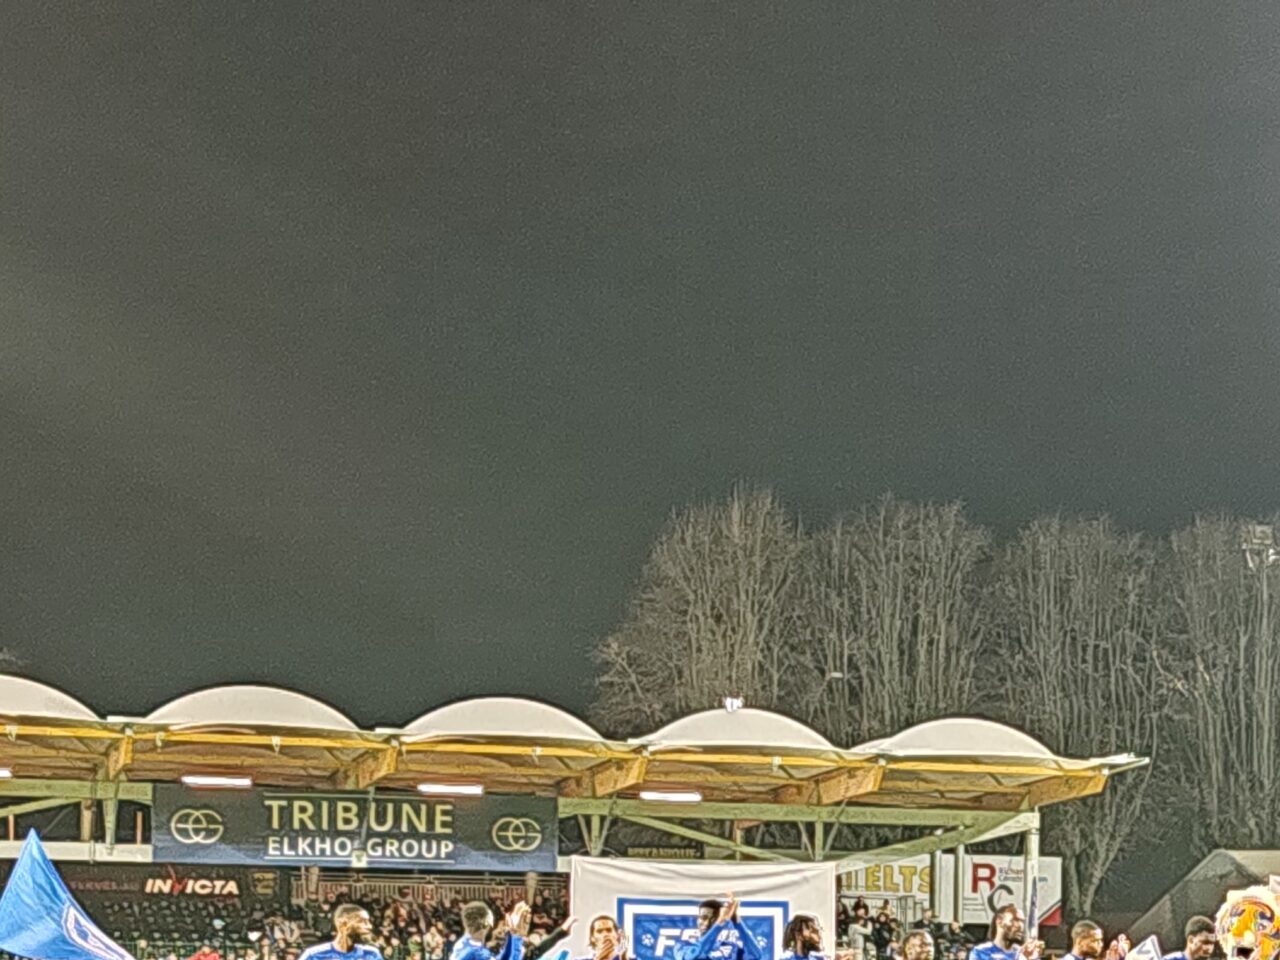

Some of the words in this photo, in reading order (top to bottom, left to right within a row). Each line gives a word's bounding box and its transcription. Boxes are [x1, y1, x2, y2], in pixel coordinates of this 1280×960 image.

[264, 800, 453, 834] TRIBUNE
[366, 837, 454, 858] GROUP
[144, 868, 239, 896] INVICTA
